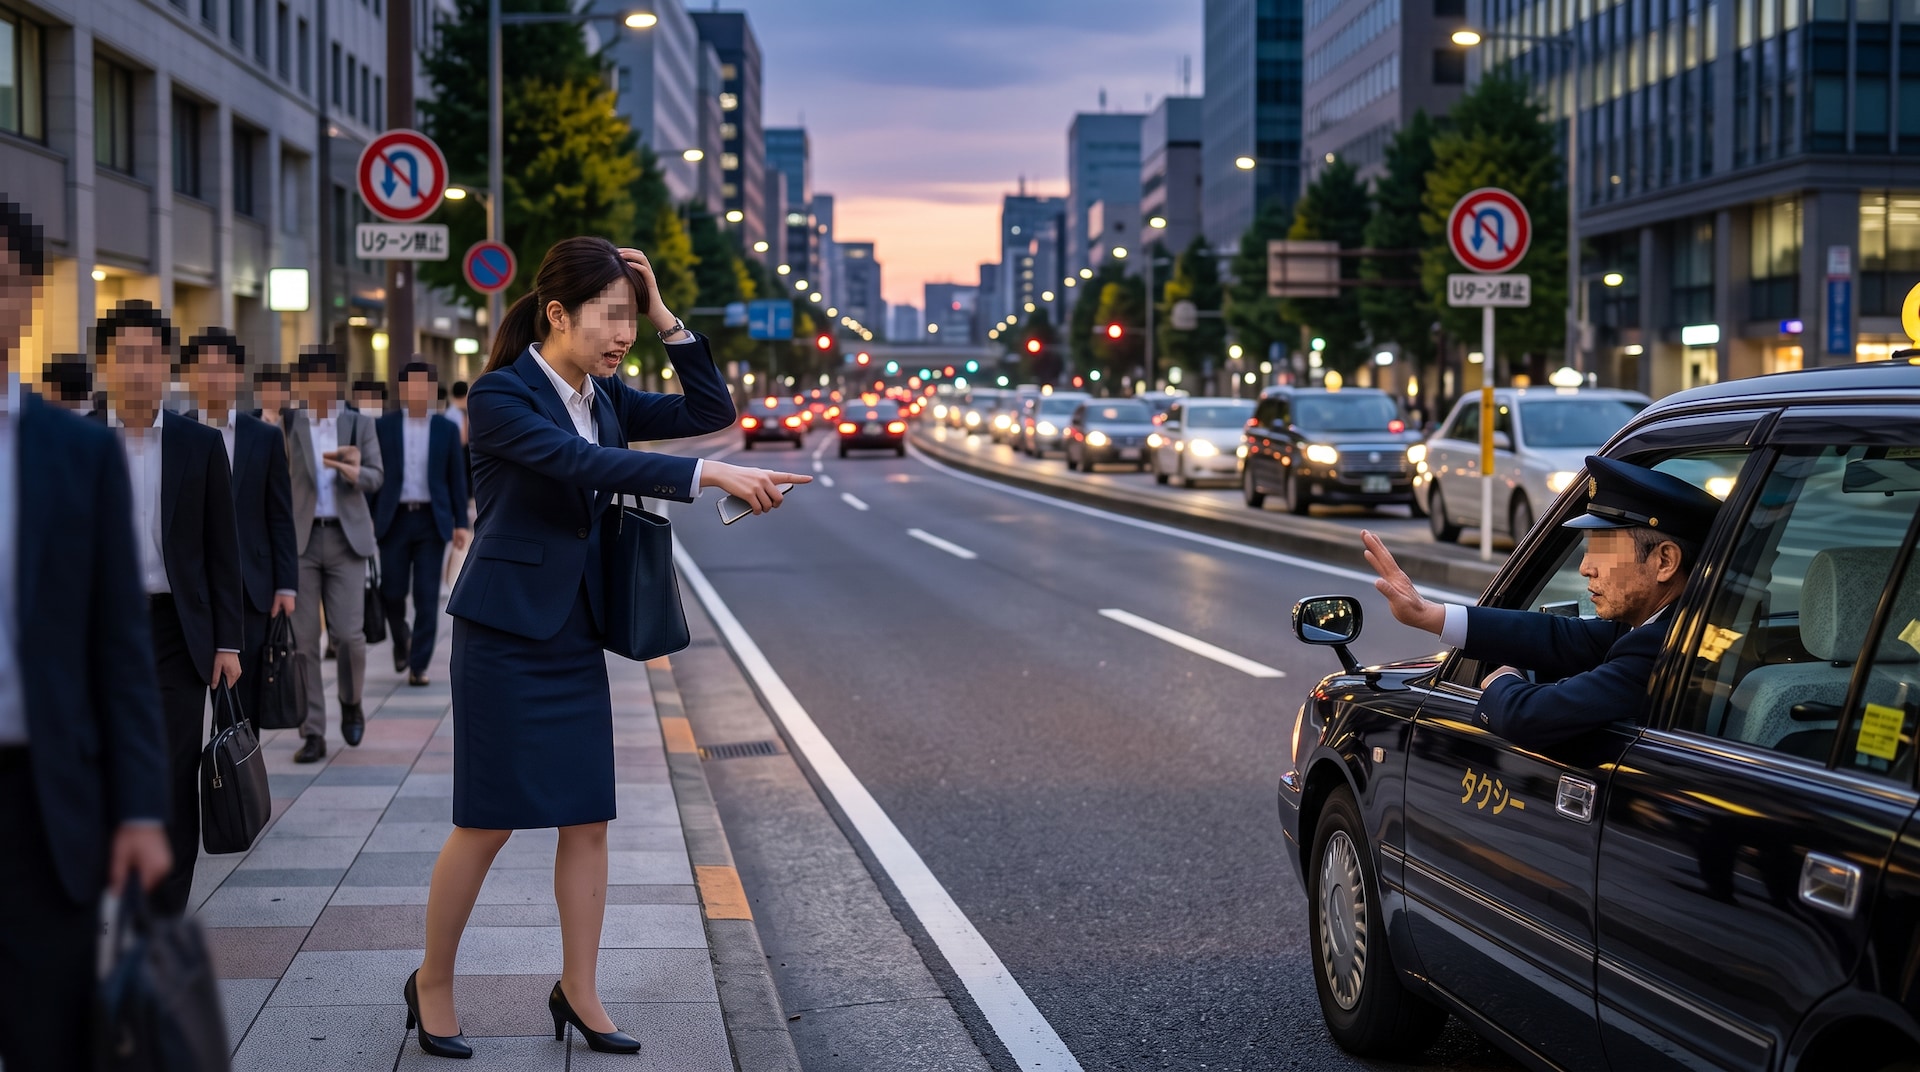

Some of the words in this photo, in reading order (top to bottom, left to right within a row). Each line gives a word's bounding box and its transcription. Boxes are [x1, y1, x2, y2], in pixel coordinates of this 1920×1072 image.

[361, 231, 443, 253] Uターン禁止
[1453, 281, 1525, 300] Uターン禁止
[1461, 767, 1525, 815] タクシー
